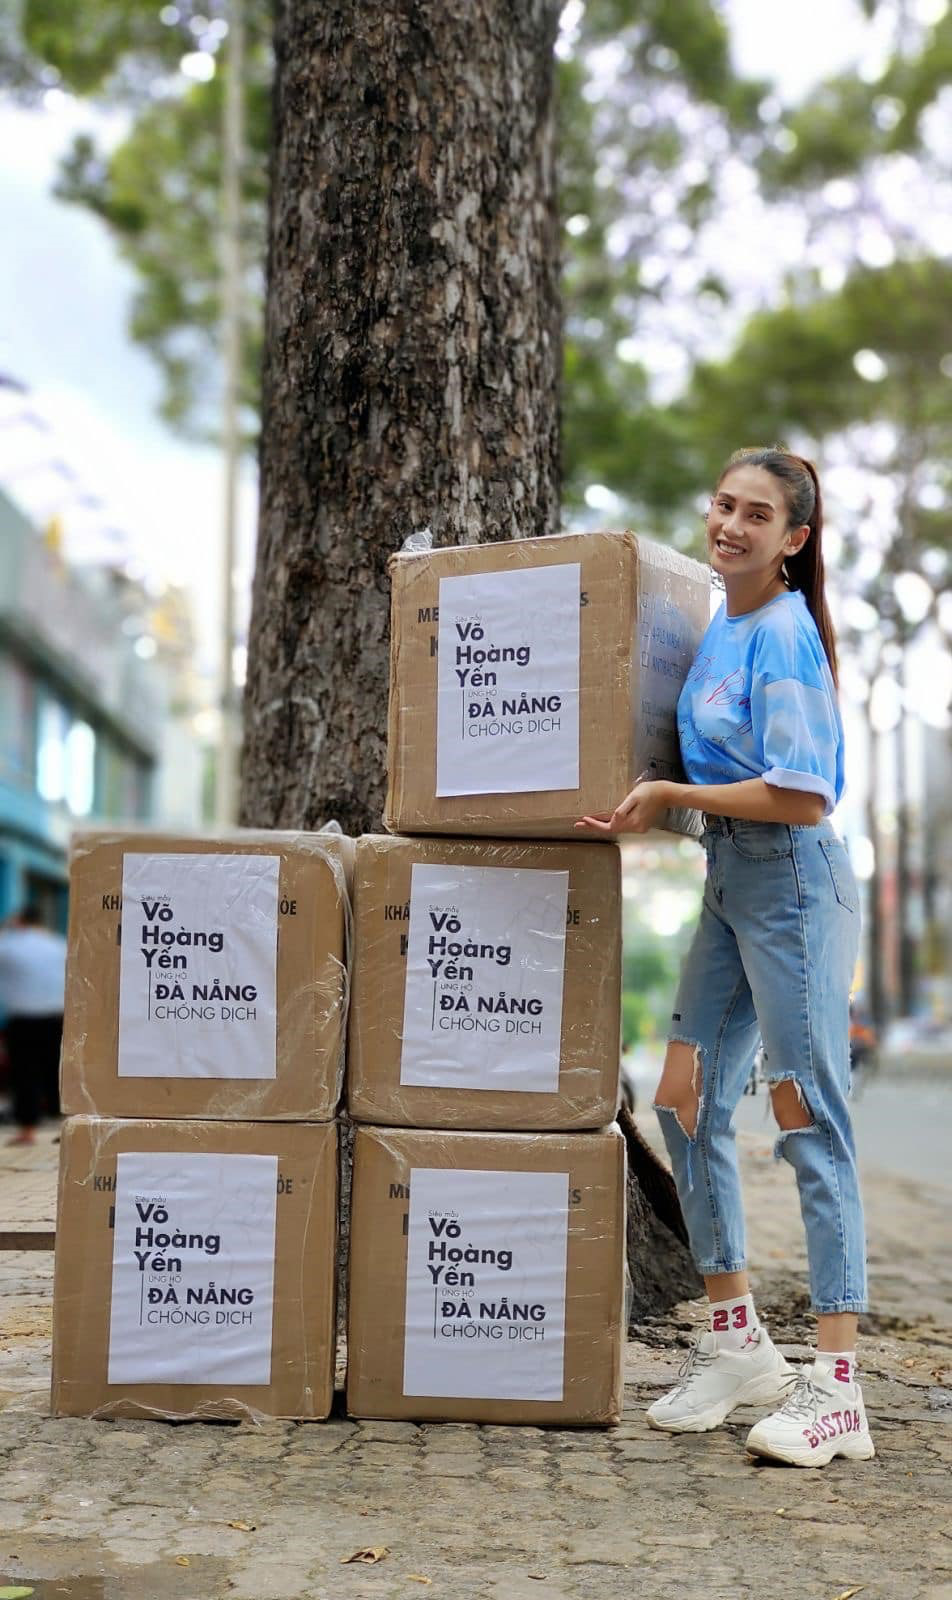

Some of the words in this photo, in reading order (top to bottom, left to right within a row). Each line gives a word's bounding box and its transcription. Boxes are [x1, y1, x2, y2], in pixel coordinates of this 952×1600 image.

[455, 622, 485, 642] Võ
[456, 644, 531, 667] Hoàng
[455, 664, 497, 688] Yến
[468, 697, 496, 719] ĐÀ
[502, 692, 562, 716] NẴNG
[468, 718, 524, 738] CHỐNG
[528, 716, 561, 735] DỊCH
[141, 902, 174, 922] Võ
[429, 912, 462, 934] Võ
[142, 926, 224, 953] Hoàng
[428, 935, 512, 966] Hoàng
[141, 946, 187, 969] Yến
[427, 957, 474, 981] Yến
[155, 980, 185, 1001] ĐÀ
[192, 978, 258, 1002] NẴNG
[155, 1001, 216, 1020] CHỐNG
[221, 1006, 257, 1022] DỊCH
[440, 991, 470, 1012] ĐÀ
[477, 991, 544, 1016] NẴNG
[439, 1013, 501, 1033] CHỐNG
[506, 1020, 542, 1036] DỊCH
[135, 1203, 169, 1224] Võ
[428, 1217, 462, 1239] Võ
[135, 1227, 221, 1255] Hoàng
[133, 1248, 182, 1273] Yến
[428, 1241, 513, 1271] Hoàng
[427, 1263, 475, 1287] Yến
[147, 1283, 179, 1305] ĐÀ
[187, 1281, 254, 1306] NẴNG
[147, 1305, 211, 1325] CHỐNG
[216, 1310, 253, 1327] DỊCH
[441, 1297, 472, 1318] ĐÀ
[480, 1297, 547, 1322] NẴNG
[712, 1304, 748, 1332] 23
[441, 1320, 504, 1339] CHỐNG
[509, 1326, 545, 1342] DỊCH
